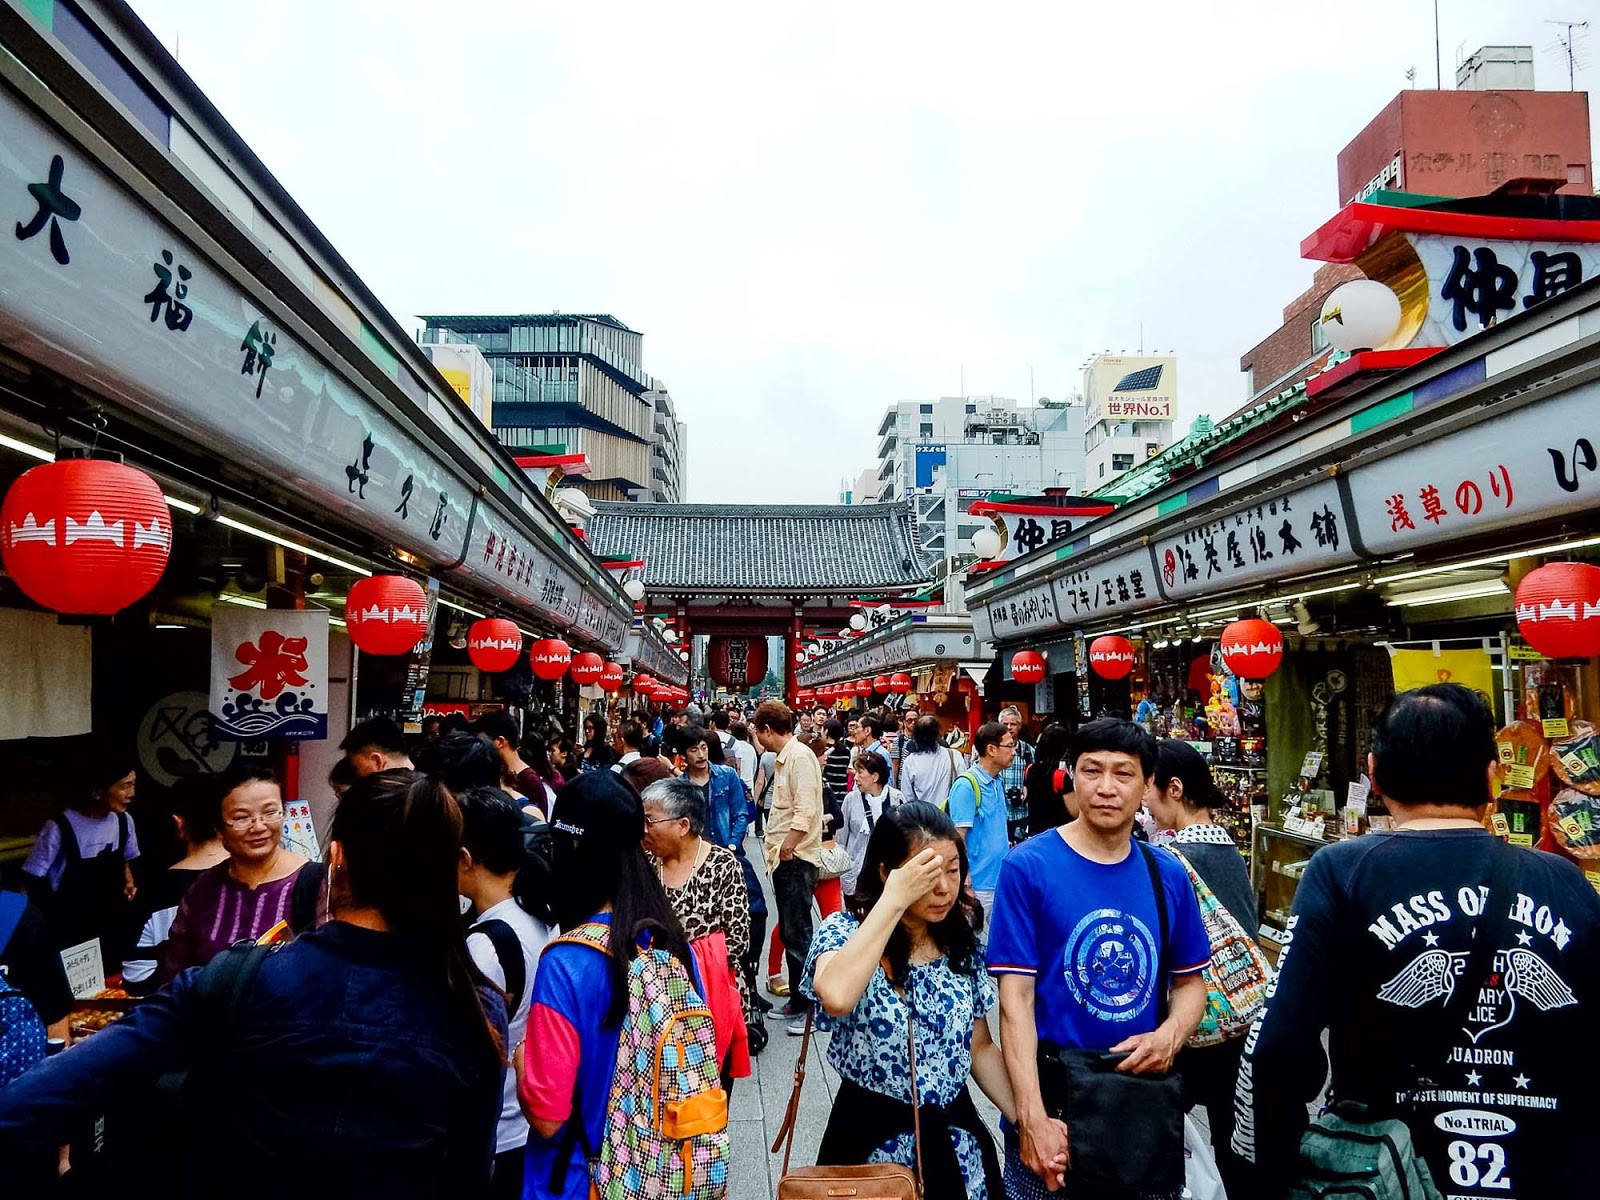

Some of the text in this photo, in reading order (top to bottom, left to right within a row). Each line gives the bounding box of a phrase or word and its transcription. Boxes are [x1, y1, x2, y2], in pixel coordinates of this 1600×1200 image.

[15, 154, 277, 399] 大福餅
[1108, 402, 1170, 416] 世界No.1
[1385, 464, 1515, 533] 浅草のり
[1013, 517, 1092, 553] 仲見
[1067, 568, 1147, 614] マキノ玉森堂
[227, 630, 309, 700] 氷
[1367, 890, 1452, 951] MASS
[1438, 1089, 1480, 1104] MOMENT
[1482, 1092, 1496, 1105] OF
[1497, 1092, 1558, 1110] SUPREMACY
[1447, 1140, 1511, 1190] 82
